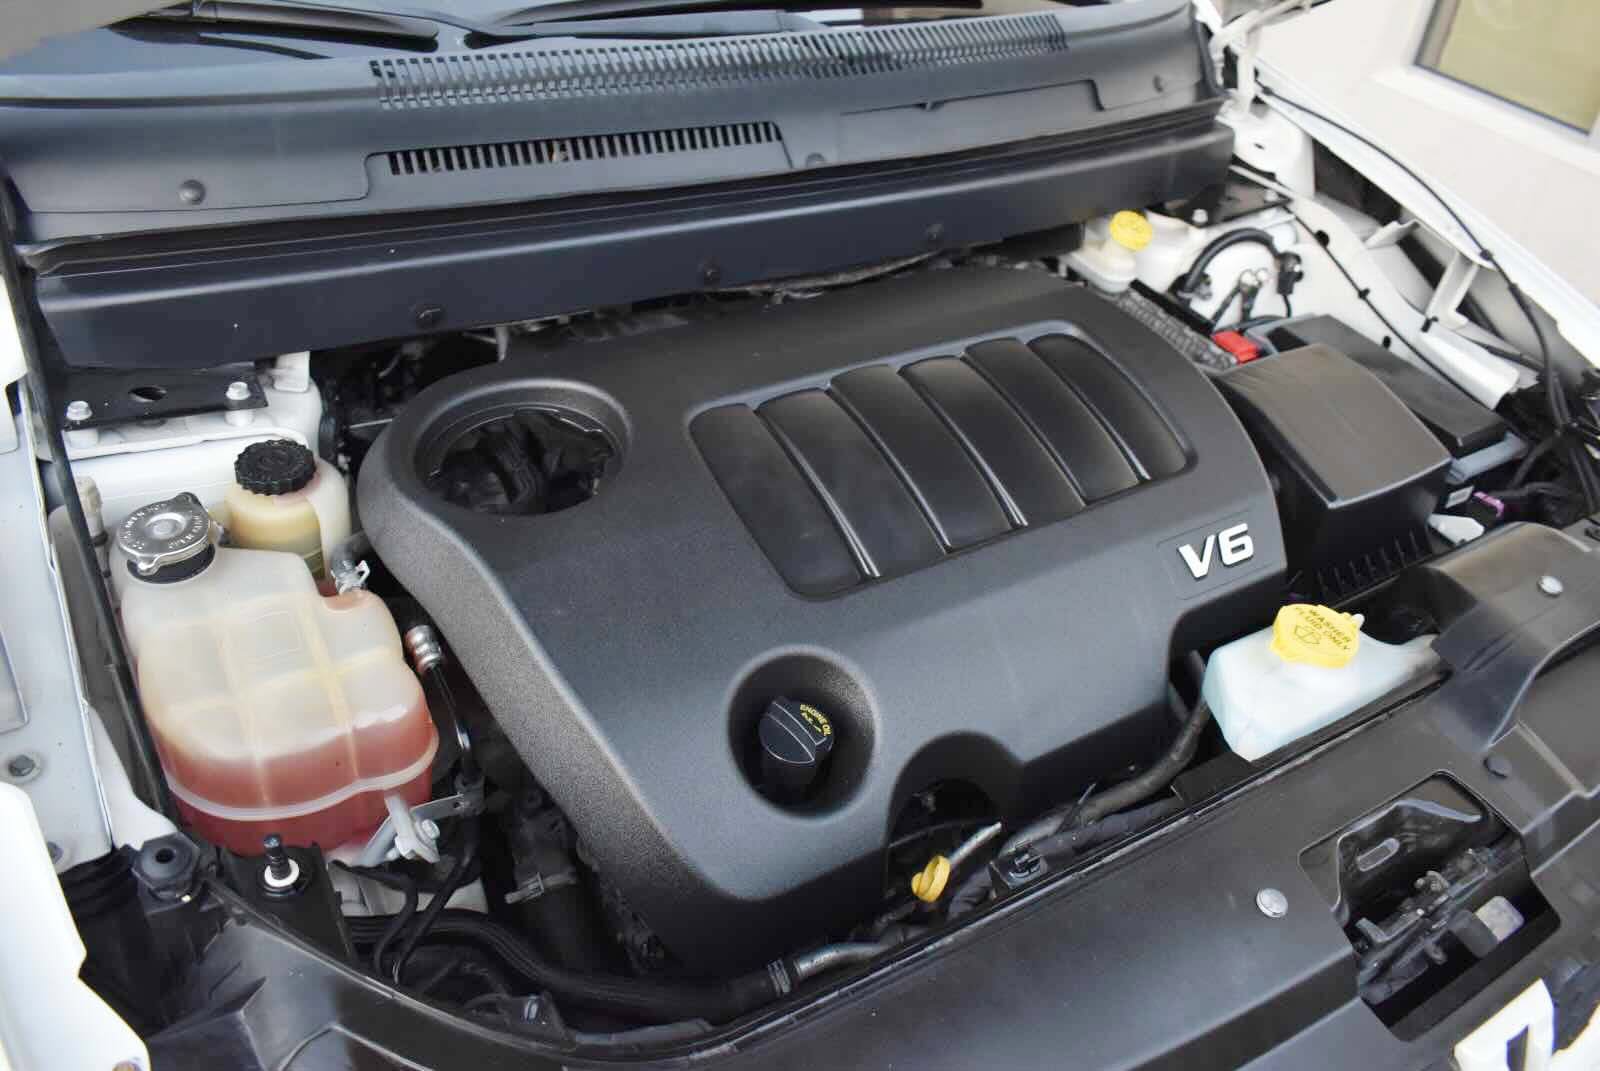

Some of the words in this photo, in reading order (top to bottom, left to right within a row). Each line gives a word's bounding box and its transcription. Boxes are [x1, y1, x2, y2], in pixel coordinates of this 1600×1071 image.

[1178, 523, 1254, 578] V6
[1309, 609, 1352, 644] WASHER
[1322, 629, 1351, 651] ONLY
